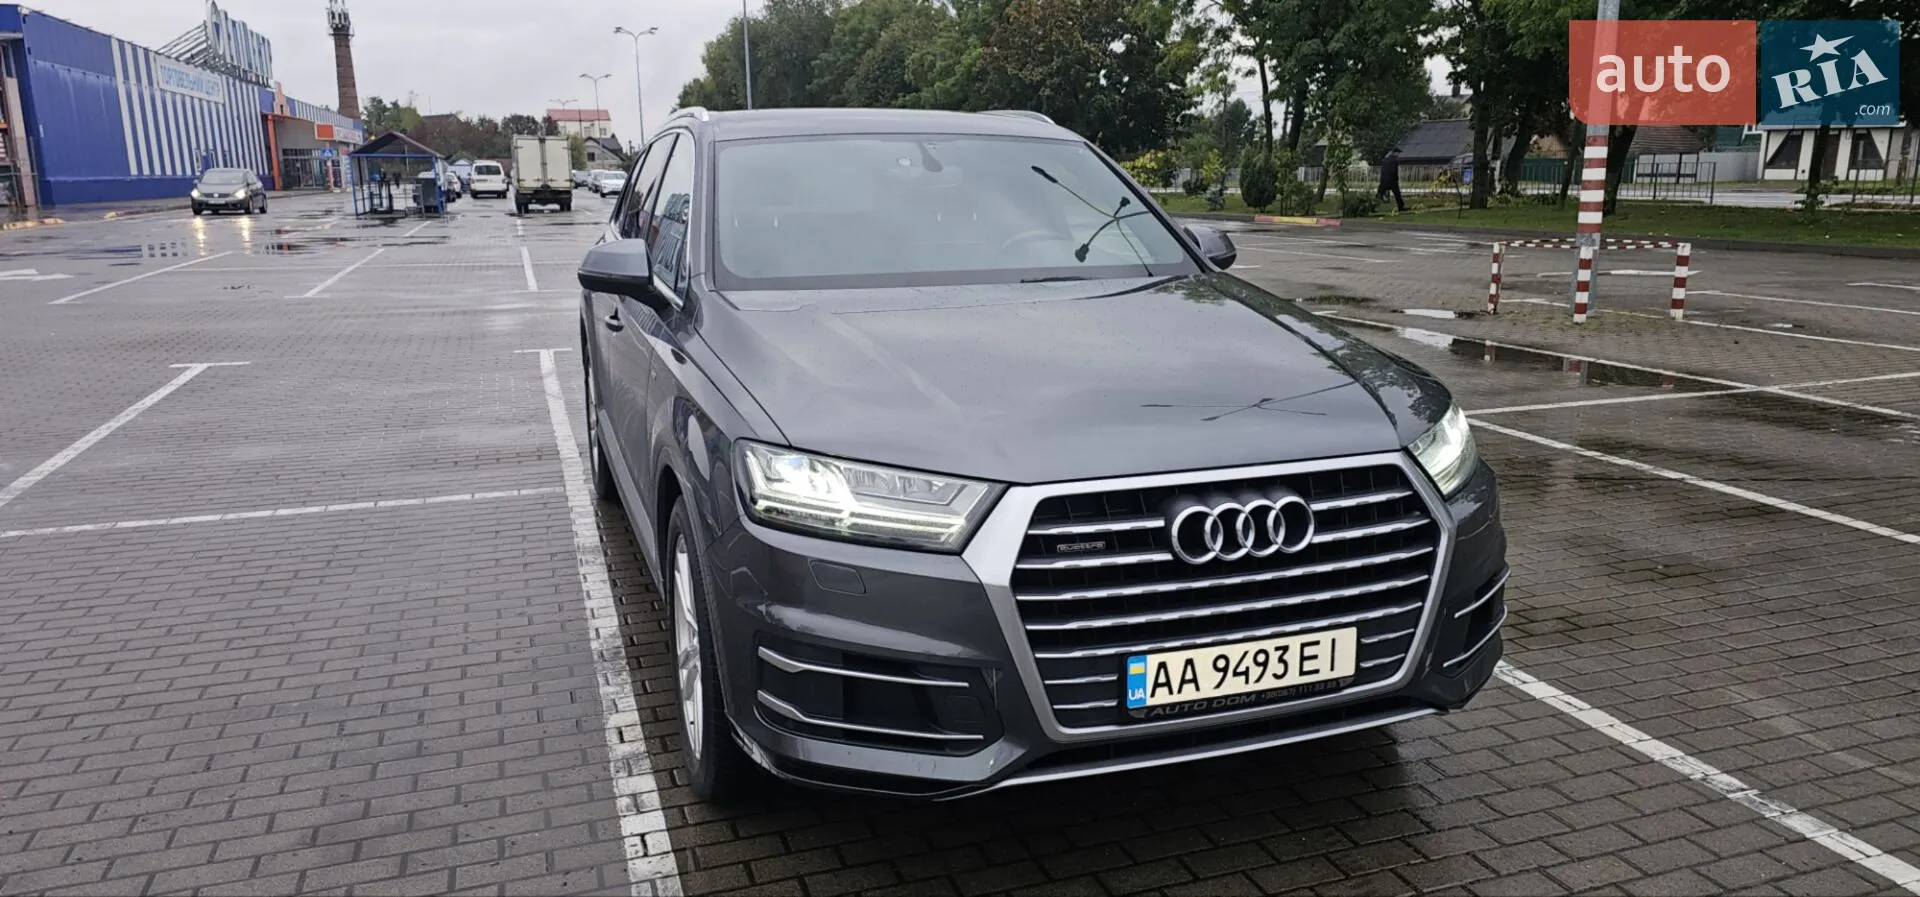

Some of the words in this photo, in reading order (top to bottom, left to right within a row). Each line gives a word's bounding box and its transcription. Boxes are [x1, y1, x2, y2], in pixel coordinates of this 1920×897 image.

[1150, 657, 1200, 698] AA
[1212, 645, 1289, 690] 9493
[1299, 638, 1336, 677] EI
[1128, 688, 1145, 700] UA
[1150, 701, 1207, 716] AUTO
[1212, 694, 1257, 709] DOM
